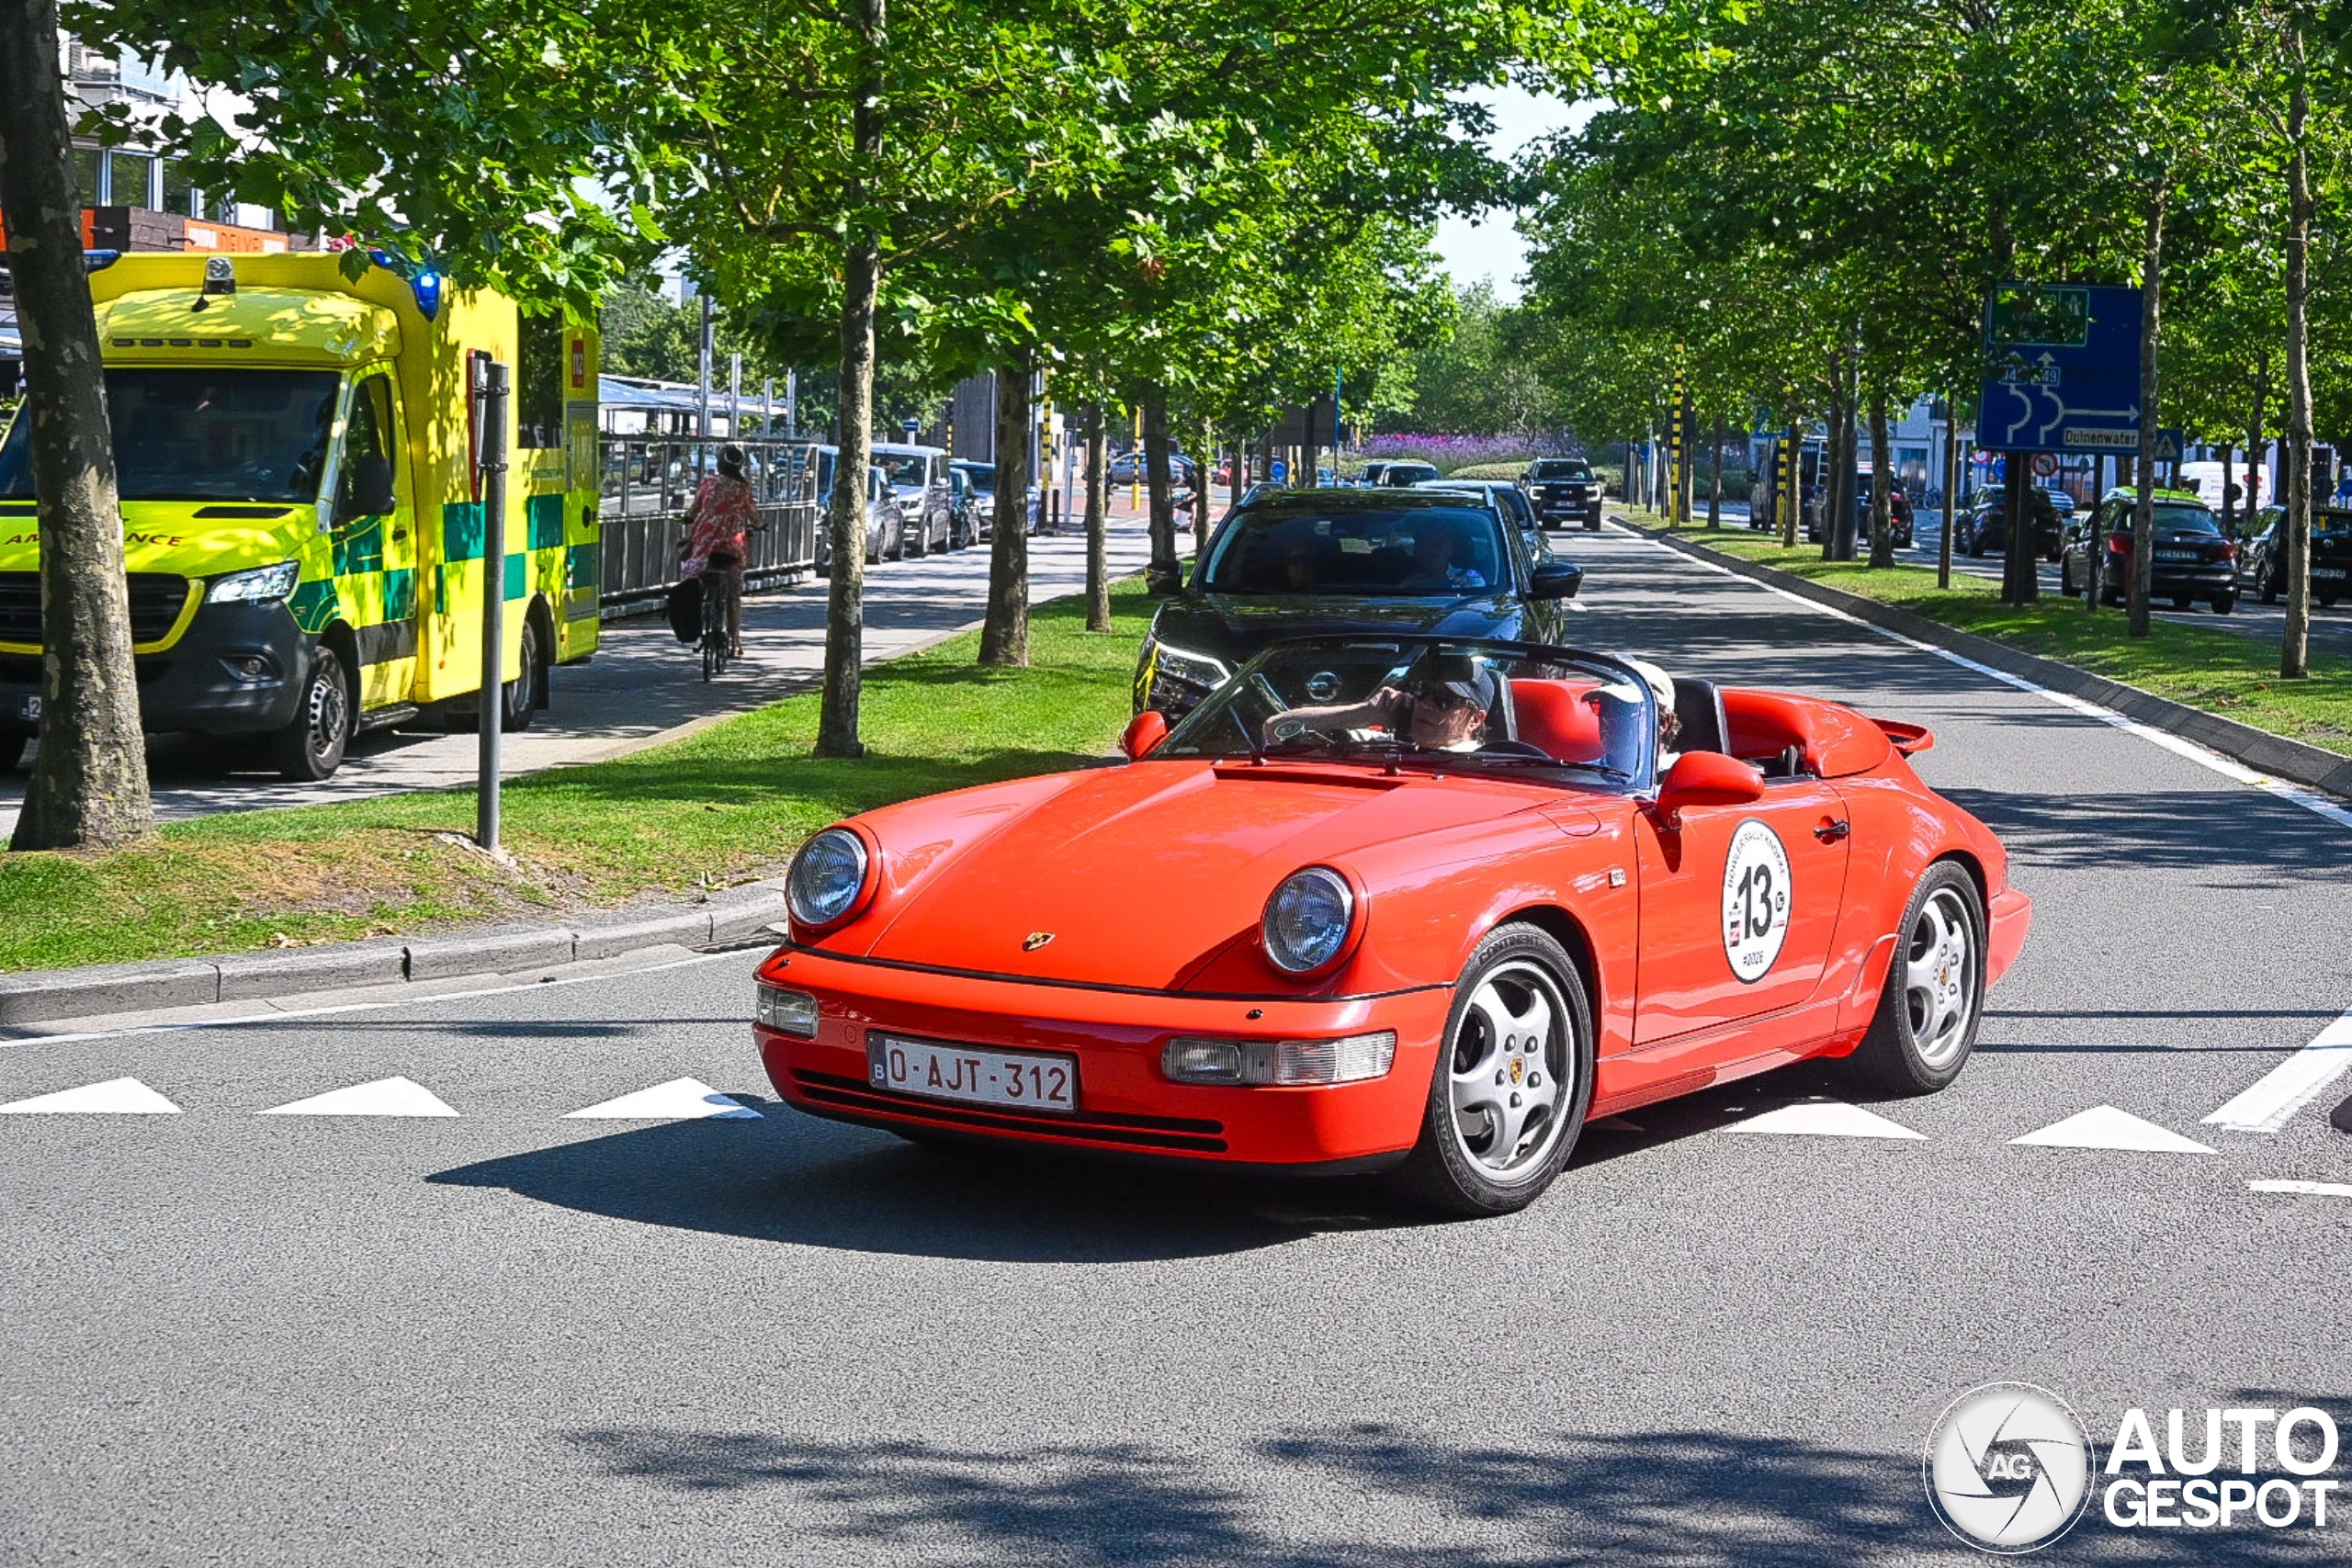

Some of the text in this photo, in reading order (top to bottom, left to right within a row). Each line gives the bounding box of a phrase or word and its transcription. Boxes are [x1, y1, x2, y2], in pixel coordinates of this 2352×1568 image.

[2065, 430, 2137, 446] Duinenwater
[1737, 863, 1772, 940] 13
[874, 1064, 885, 1080] B
